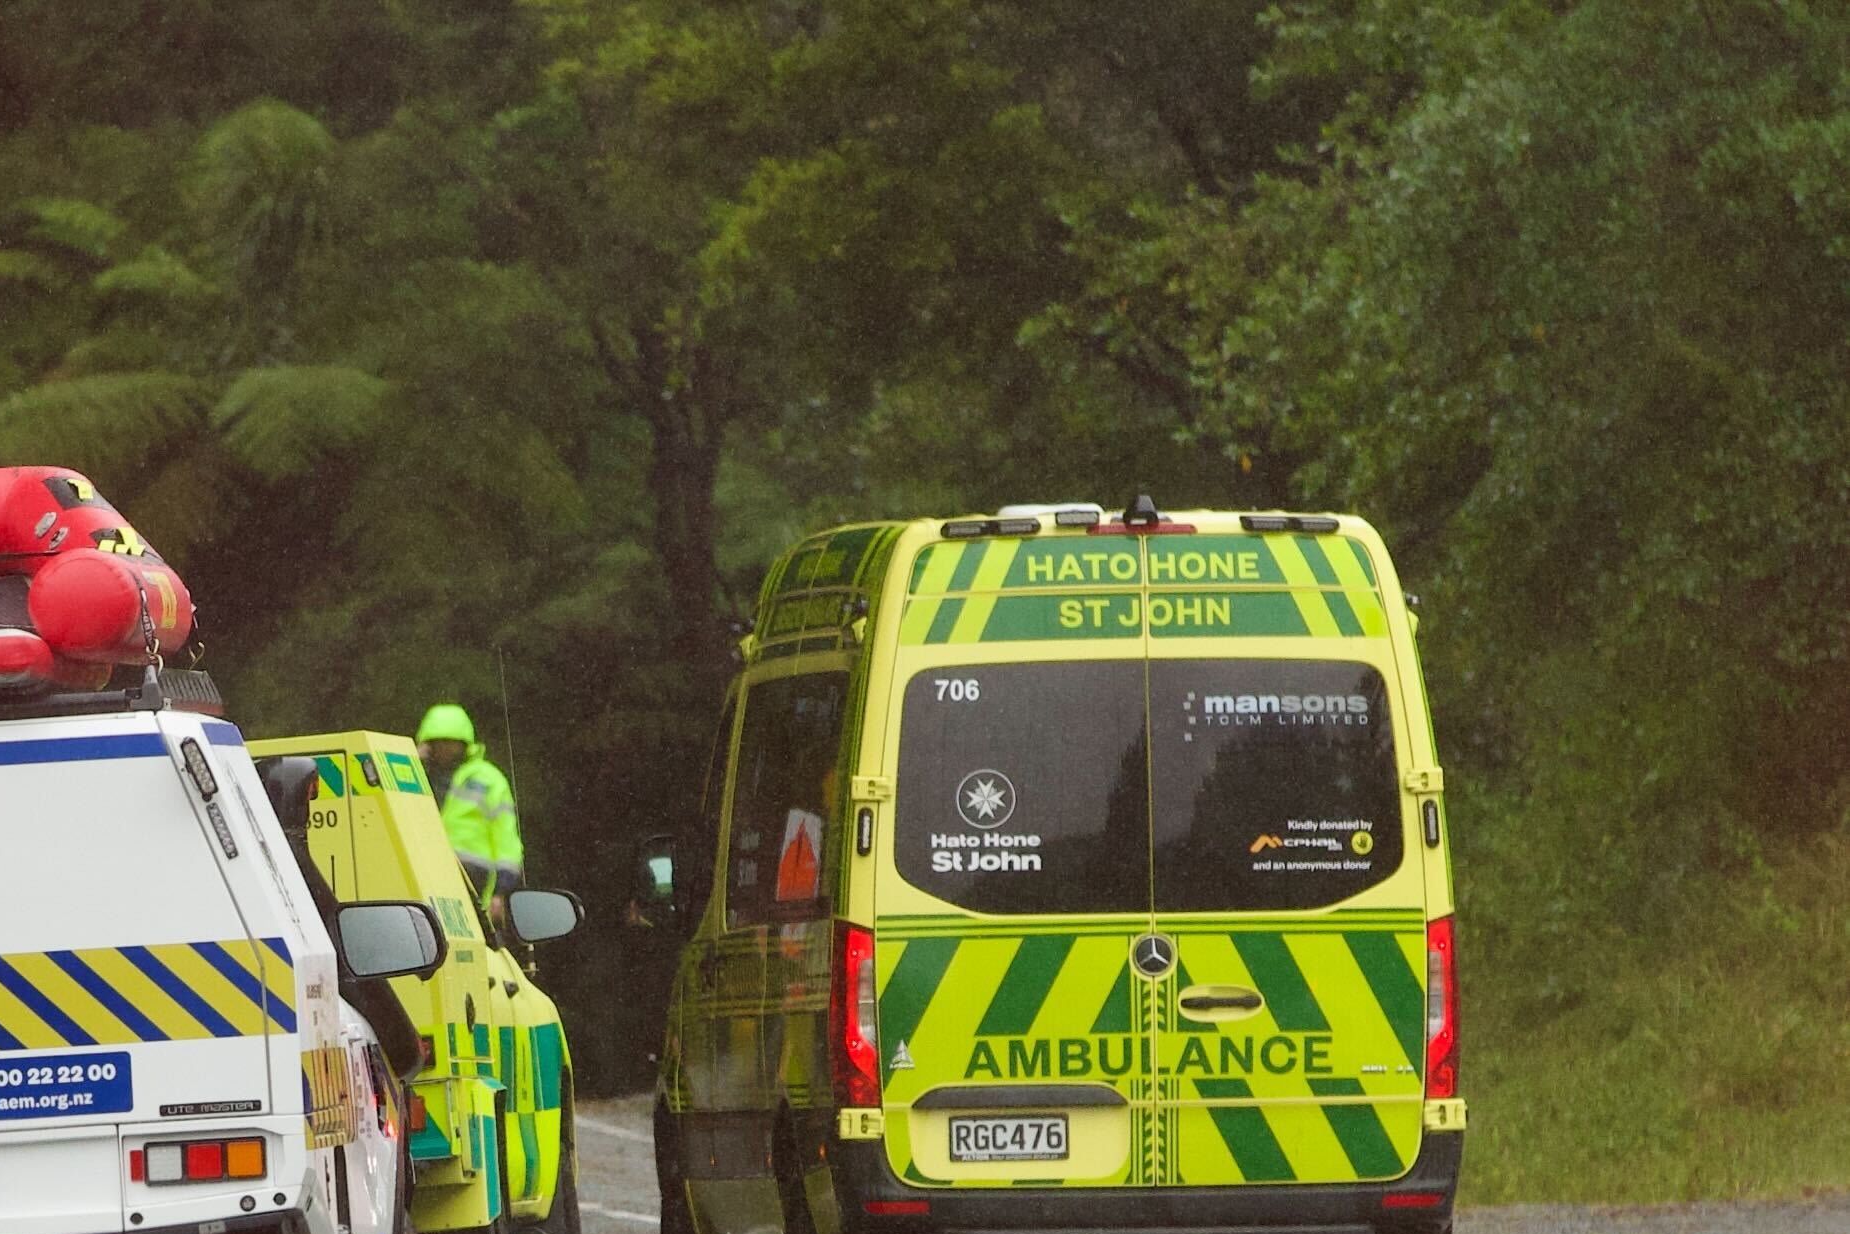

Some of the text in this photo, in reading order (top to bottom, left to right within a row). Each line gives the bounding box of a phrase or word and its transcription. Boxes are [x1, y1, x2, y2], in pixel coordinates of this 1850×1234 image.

[1026, 551, 1261, 582] HATO HONE
[1059, 598, 1232, 629] ST JOHN
[934, 679, 981, 702] 706
[1204, 694, 1369, 714] mansons
[1278, 713, 1369, 726] LIMITED
[306, 810, 338, 829] 90
[1287, 819, 1373, 832] Kindly donated by
[931, 832, 1042, 848] Hato Hone
[932, 850, 1042, 873] St John
[1253, 860, 1371, 872] and an anonymous donor
[963, 1035, 1335, 1079] AMBULANCE
[27, 1066, 54, 1085] 22
[57, 1065, 85, 1083] 22
[87, 1063, 117, 1081] 00
[954, 1122, 1063, 1151] RGC476
